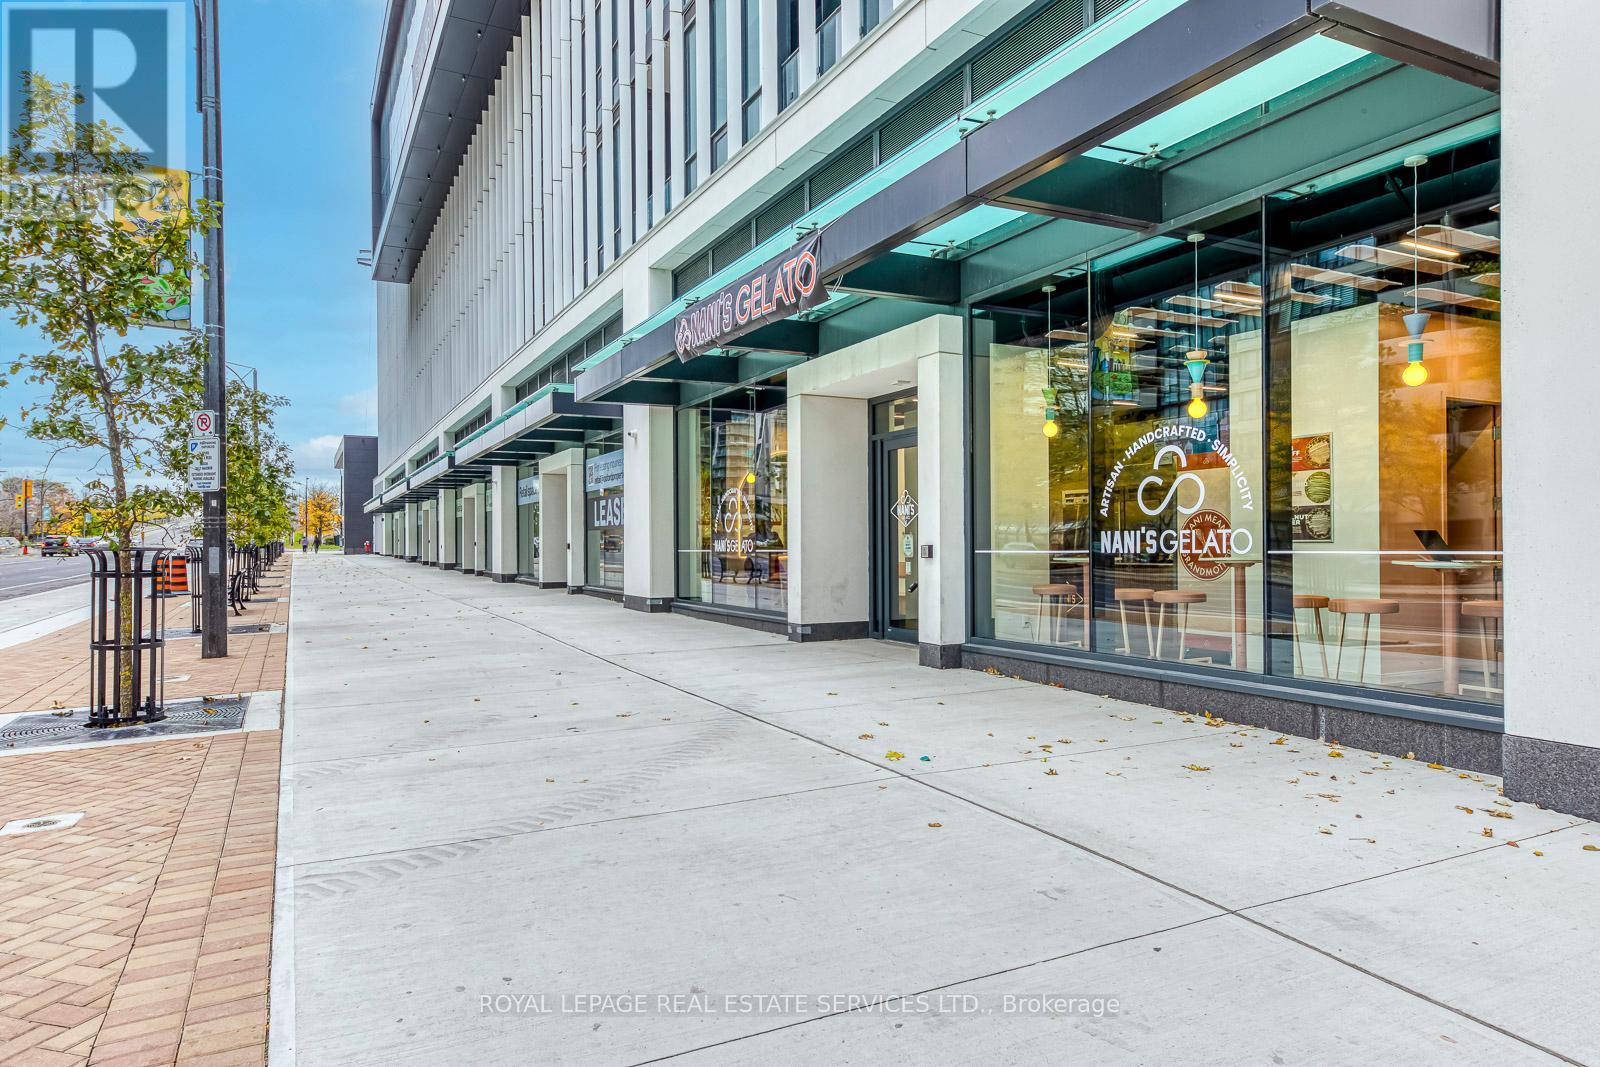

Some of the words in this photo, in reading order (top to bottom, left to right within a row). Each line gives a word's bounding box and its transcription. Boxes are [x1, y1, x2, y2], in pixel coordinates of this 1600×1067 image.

[690, 292, 733, 347] NANI'S
[735, 251, 817, 325] GELATO
[1100, 461, 1124, 517] ARTISAN
[1125, 425, 1206, 460] HANDCRAFTED
[1211, 439, 1254, 511] SIMPLICITY
[897, 504, 915, 516] NANI'S
[1100, 526, 1157, 554] NANI'S
[1159, 528, 1253, 555] GELATO
